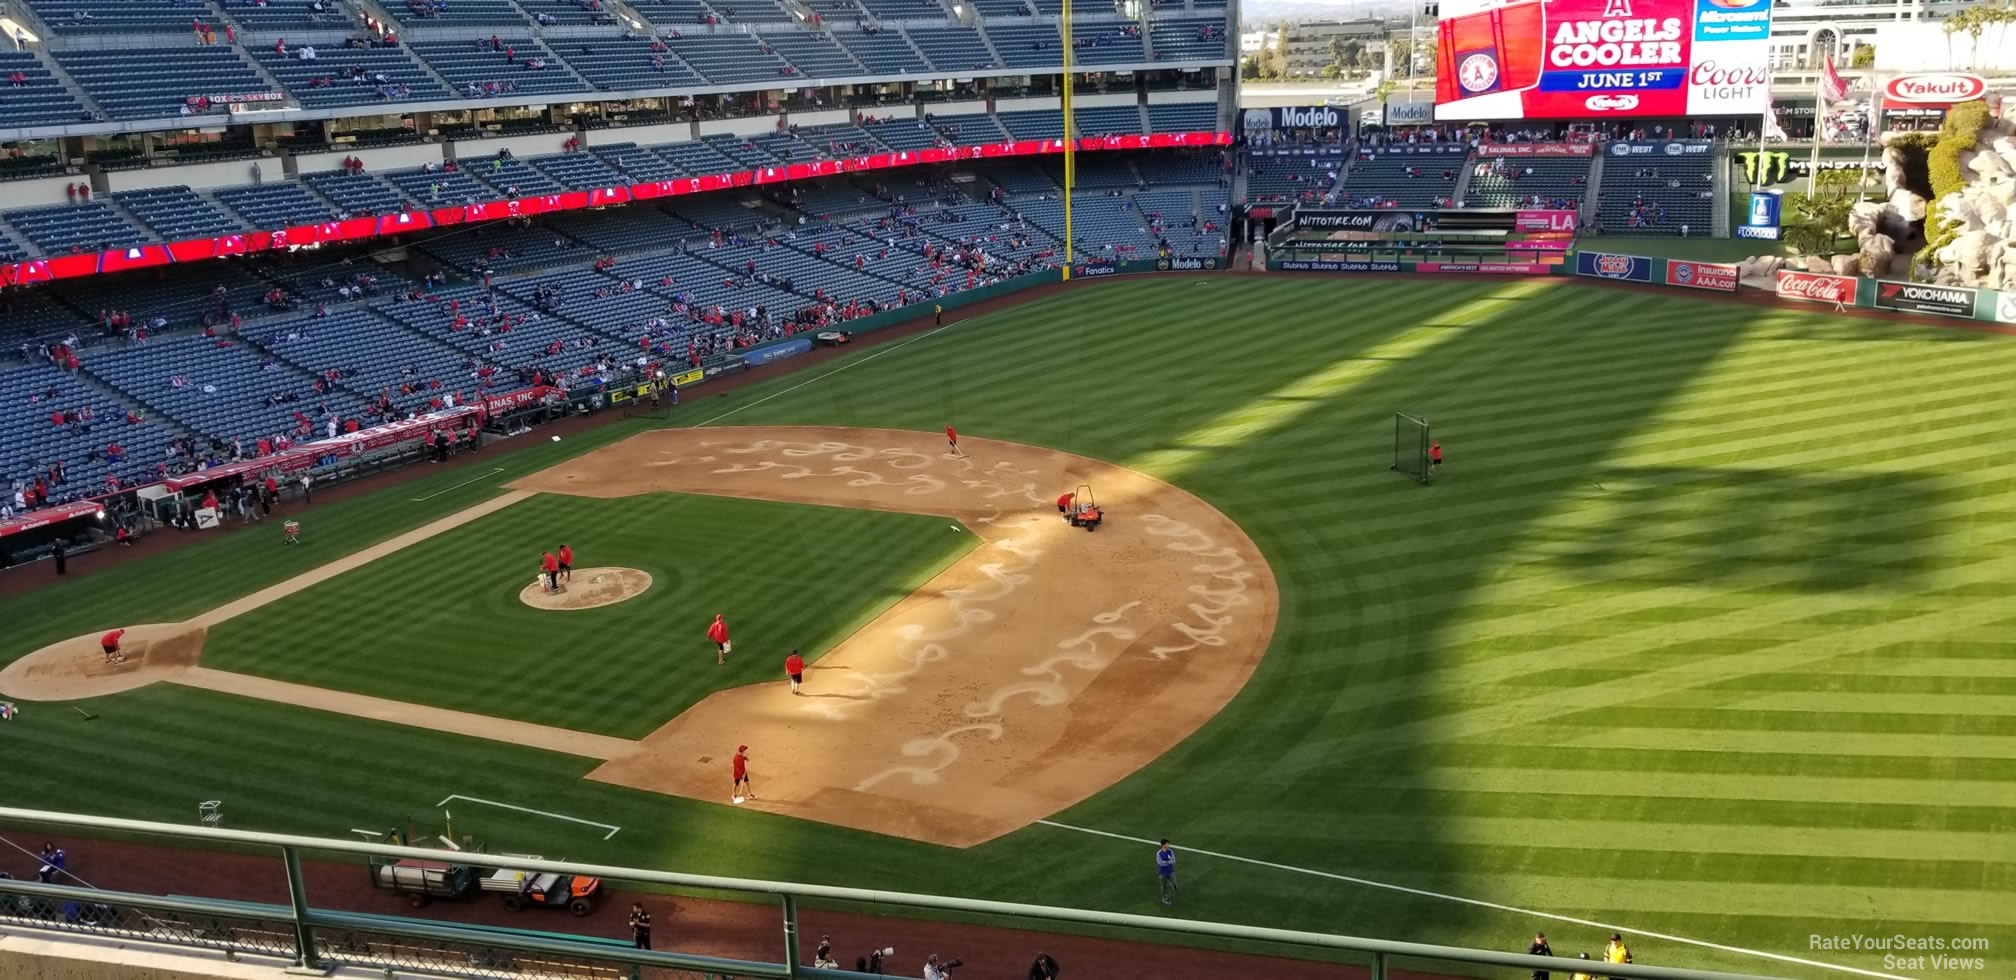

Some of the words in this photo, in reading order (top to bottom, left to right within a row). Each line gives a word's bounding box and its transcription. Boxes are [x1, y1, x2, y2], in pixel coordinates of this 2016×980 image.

[1553, 17, 1681, 45] ANGELS
[1550, 41, 1682, 67] COOLER
[1691, 60, 1767, 86] Coors
[1577, 73, 1634, 89] JUNE
[1638, 71, 1663, 87] 1ST
[1703, 87, 1754, 99] LIGHT
[1903, 82, 1969, 94] Yakult
[247, 92, 283, 101] SKYBOX
[1282, 106, 1338, 127] Modelo
[1392, 106, 1427, 120] Modelo
[1794, 107, 1816, 115] STOR
[1631, 145, 1653, 153] WEST
[1685, 145, 1707, 153] WEST
[1300, 215, 1372, 227] NITTOTIRE.COM
[1552, 214, 1575, 230] LA
[1172, 259, 1201, 269] Modelo
[1600, 254, 1628, 266] Jersey
[1086, 266, 1115, 275] Fanatics
[1283, 262, 1309, 270] StubHub
[1311, 262, 1338, 270] StubHub
[1370, 263, 1398, 271] StubHub
[1778, 274, 1843, 299] Coca-Cola
[517, 391, 535, 403] INC
